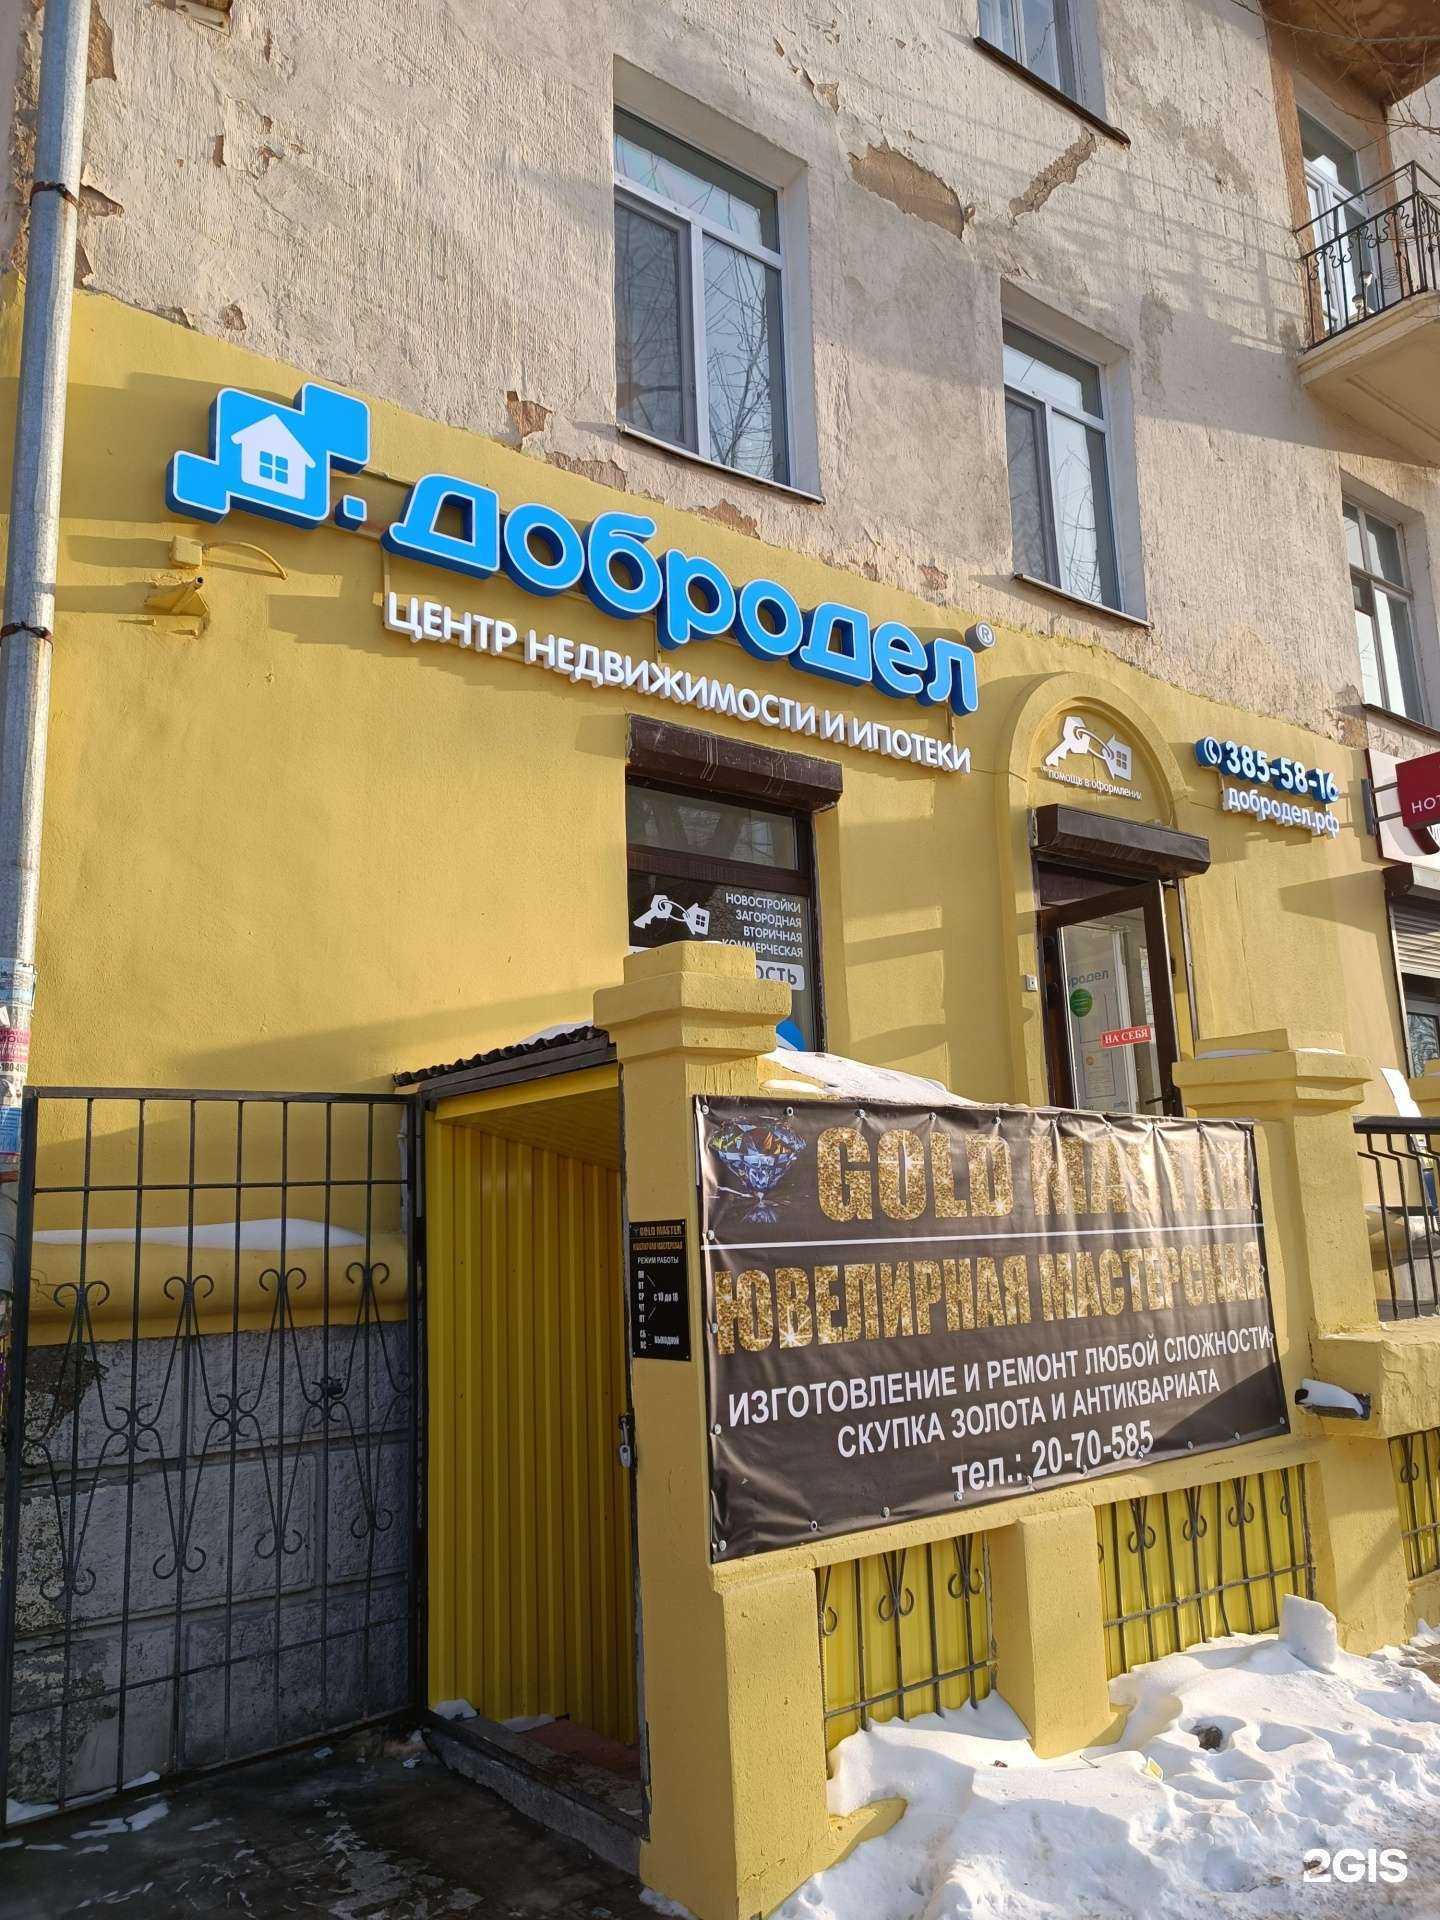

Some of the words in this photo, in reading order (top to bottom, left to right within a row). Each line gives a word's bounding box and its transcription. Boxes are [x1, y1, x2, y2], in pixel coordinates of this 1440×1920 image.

[389, 473, 979, 713] Добродел
[388, 591, 518, 655] ЦЕНТР
[528, 629, 816, 734] НЕДВИЖИМОСТИ
[824, 709, 845, 741] И
[852, 717, 971, 774] ИПОТЕКИ
[1225, 740, 1340, 802] 385-58-16
[1228, 787, 1340, 838] добродел.рф
[725, 892, 801, 913] НОВОСТРОЙКИ
[735, 909, 802, 928] ЗАГОРОДНАЯ
[743, 925, 803, 944] ВТОРИЧНАЯ
[755, 964, 798, 985] ОСТЬ
[1104, 1033, 1120, 1044] НА
[1121, 1028, 1148, 1041] СЕБЯ
[816, 1126, 1014, 1222] GOLD
[714, 1254, 1032, 1355] ЮВЕЛИРНАЯ
[1038, 1241, 1265, 1322] МАСТЕРСКАЯ
[729, 1366, 958, 1427] ИЗГОТОВЛЕНИЕ
[963, 1363, 981, 1393] И
[986, 1350, 1078, 1390] РЕМОНТ
[1085, 1334, 1160, 1376] ЛЮБОЙ
[1164, 1325, 1271, 1363] СЛОЖНОСТИ
[837, 1412, 946, 1458] СКУПКА
[951, 1396, 1046, 1439] ЗОЛОТА
[1051, 1392, 1067, 1421] И
[1072, 1368, 1221, 1418] АНТИКВАРИАТА
[1031, 1420, 1154, 1478] 20-70-585
